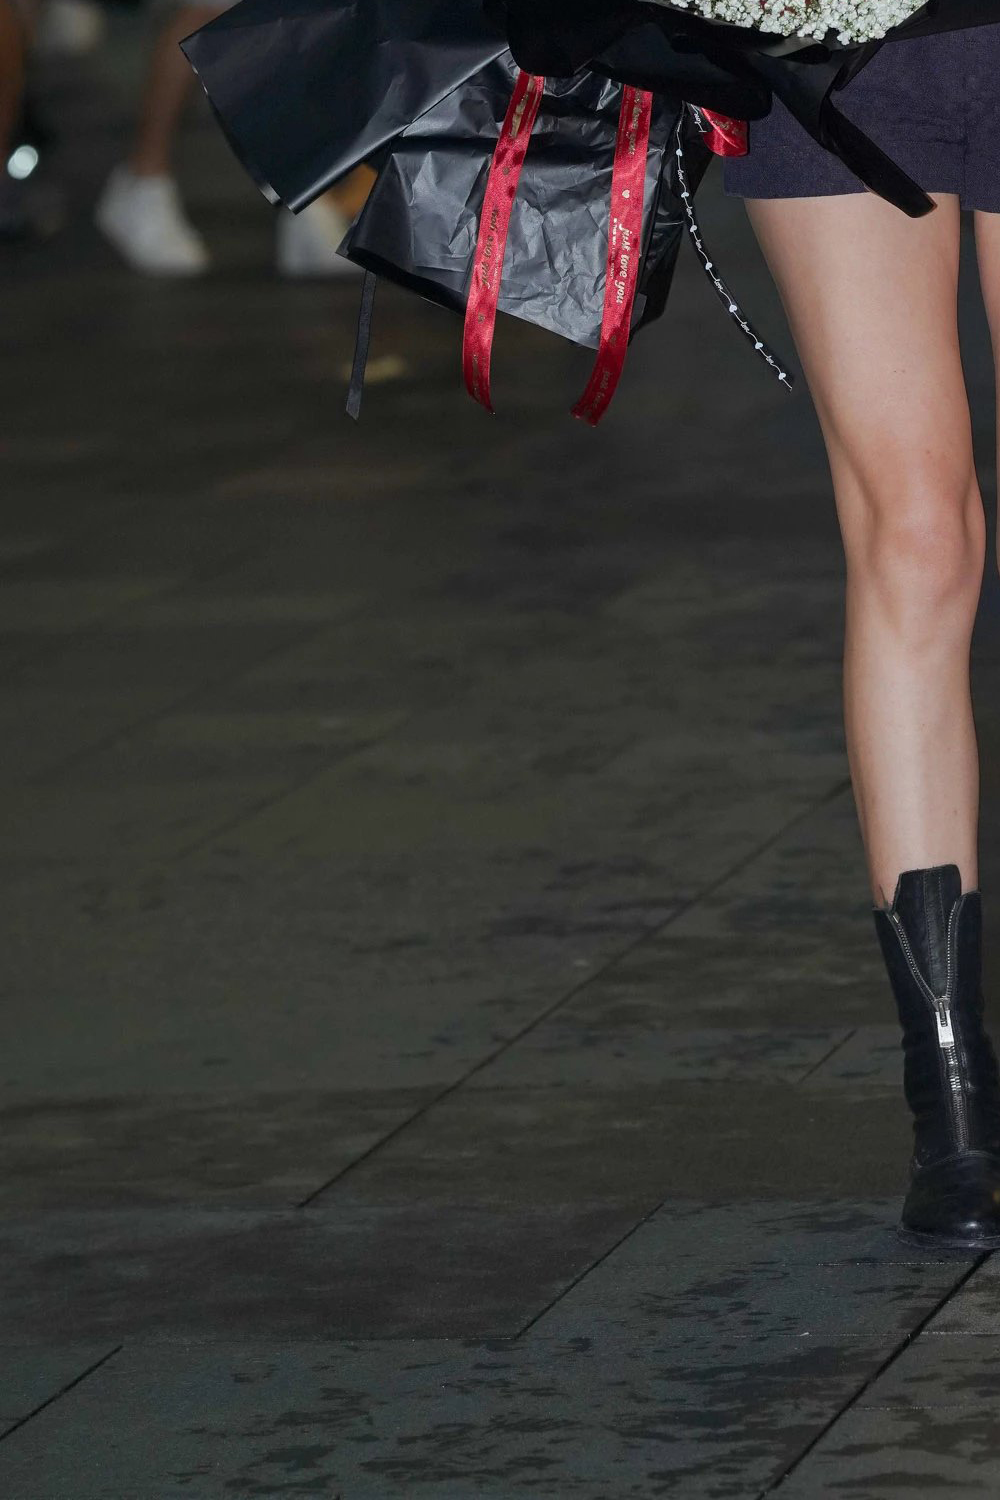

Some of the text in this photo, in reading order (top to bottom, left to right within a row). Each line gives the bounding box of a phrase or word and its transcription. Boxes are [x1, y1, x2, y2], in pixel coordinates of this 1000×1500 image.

[615, 223, 633, 304] just love you
